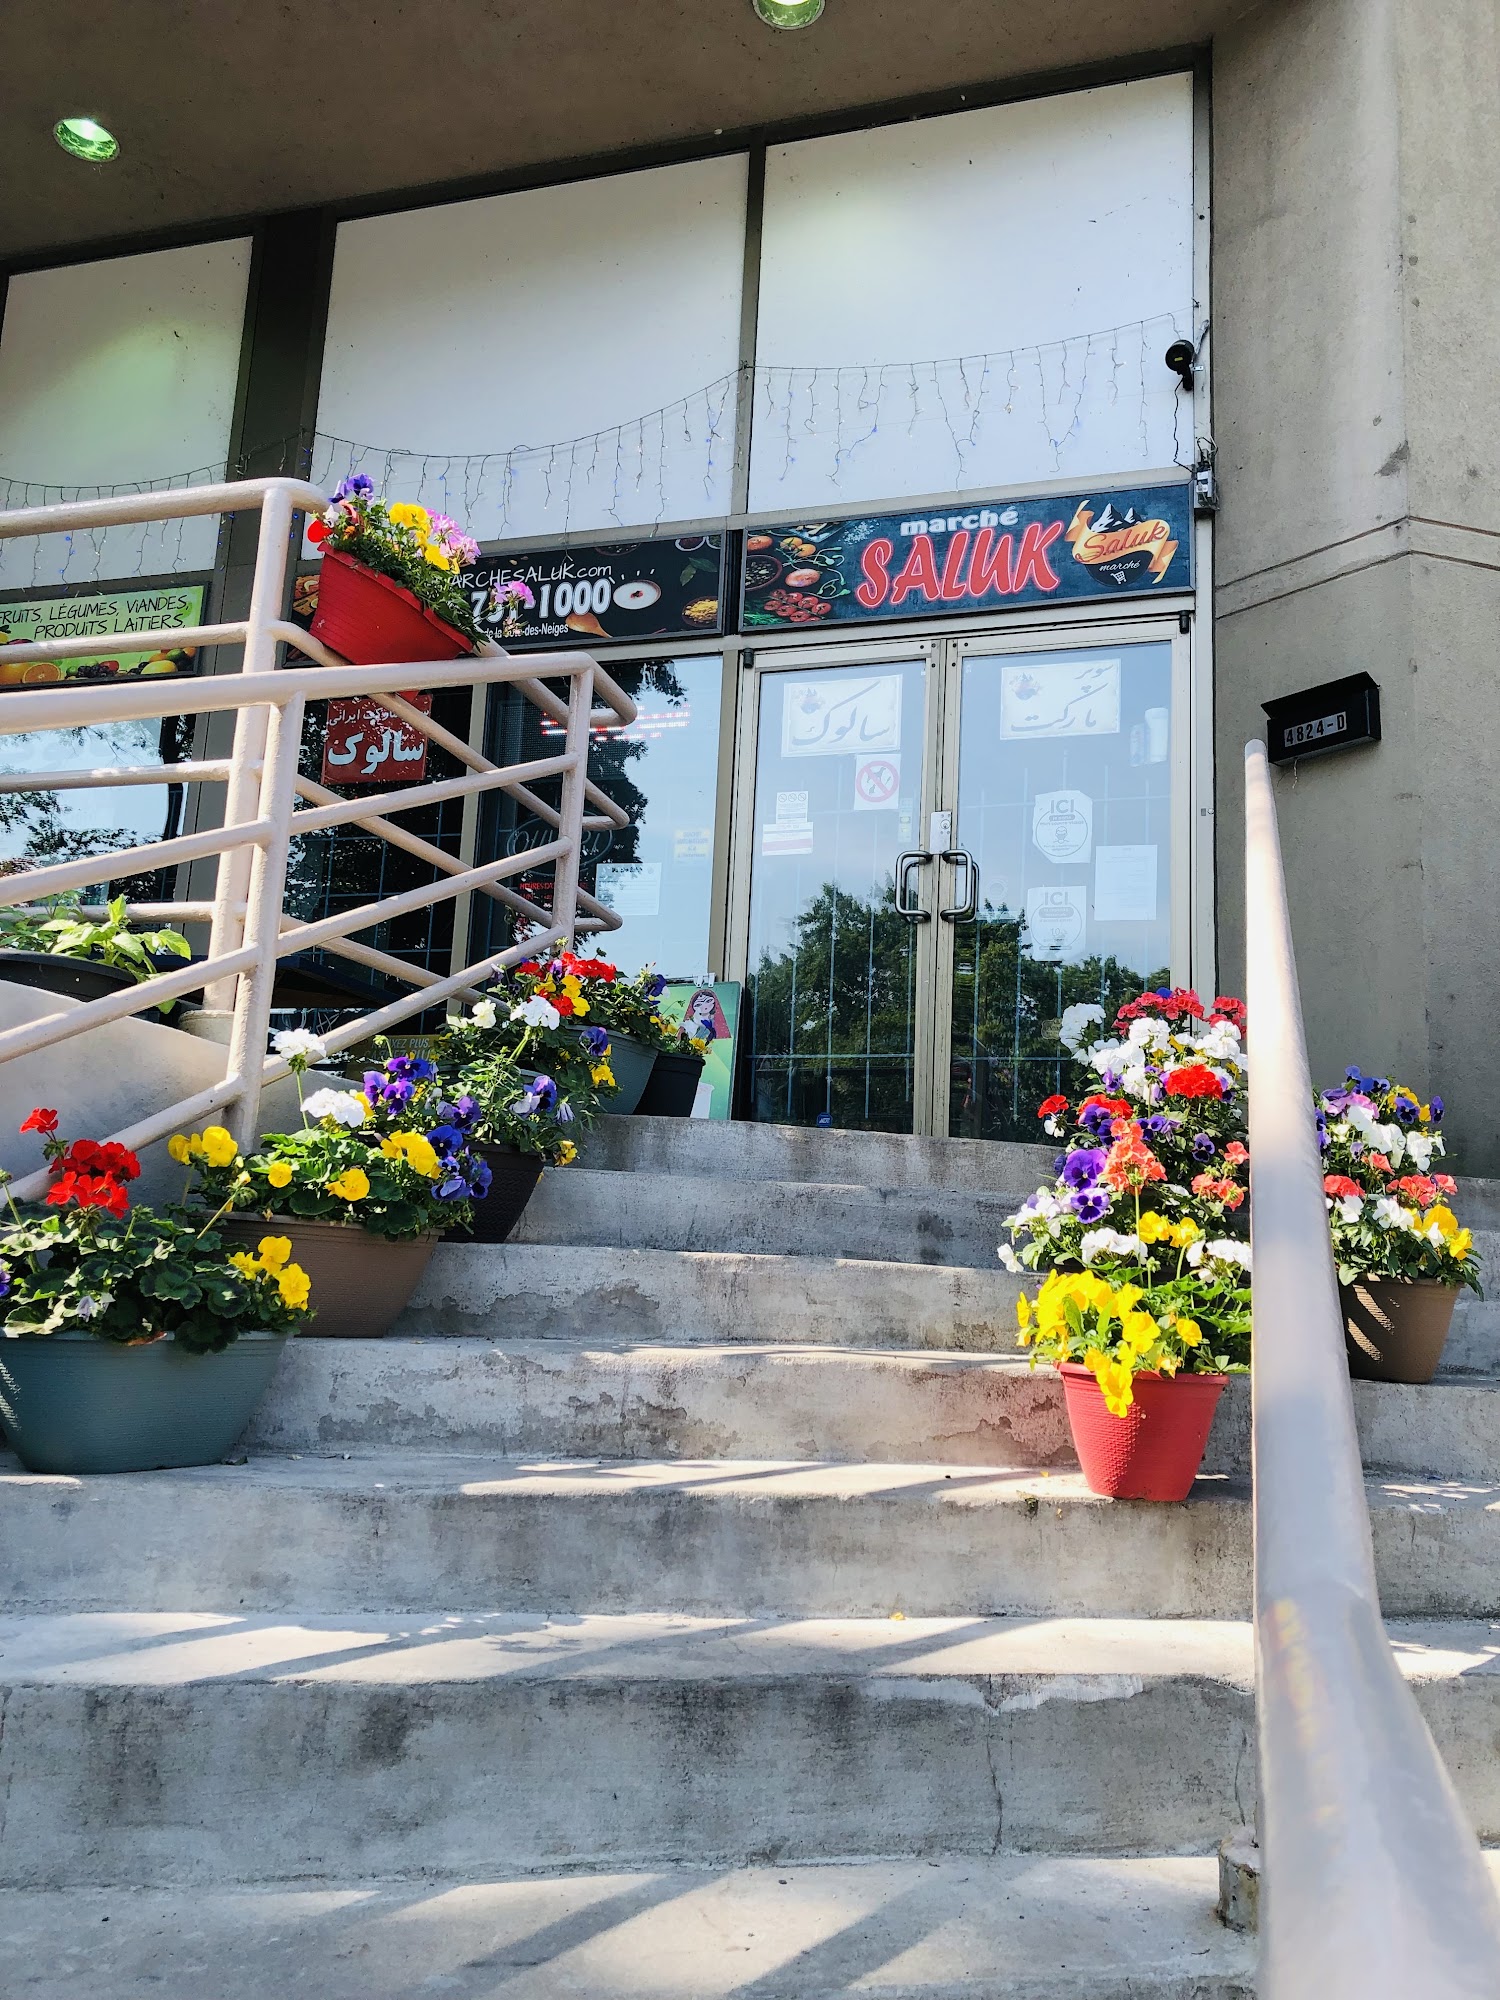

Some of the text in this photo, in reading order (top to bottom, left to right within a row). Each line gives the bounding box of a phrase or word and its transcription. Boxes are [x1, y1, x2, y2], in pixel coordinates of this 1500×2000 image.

[900, 506, 1018, 536] marché
[1075, 521, 1168, 562] Saluk
[451, 562, 612, 589] ARCHESALUK.com
[856, 520, 1064, 609] SALUK
[1099, 560, 1140, 571] marché
[49, 601, 119, 621] LÉGUMES,
[792, 681, 890, 746] سالوک
[1286, 715, 1344, 744] 4824-D
[328, 729, 424, 774] سالوک
[1051, 799, 1074, 813] ICI
[1045, 892, 1068, 905] ICI
